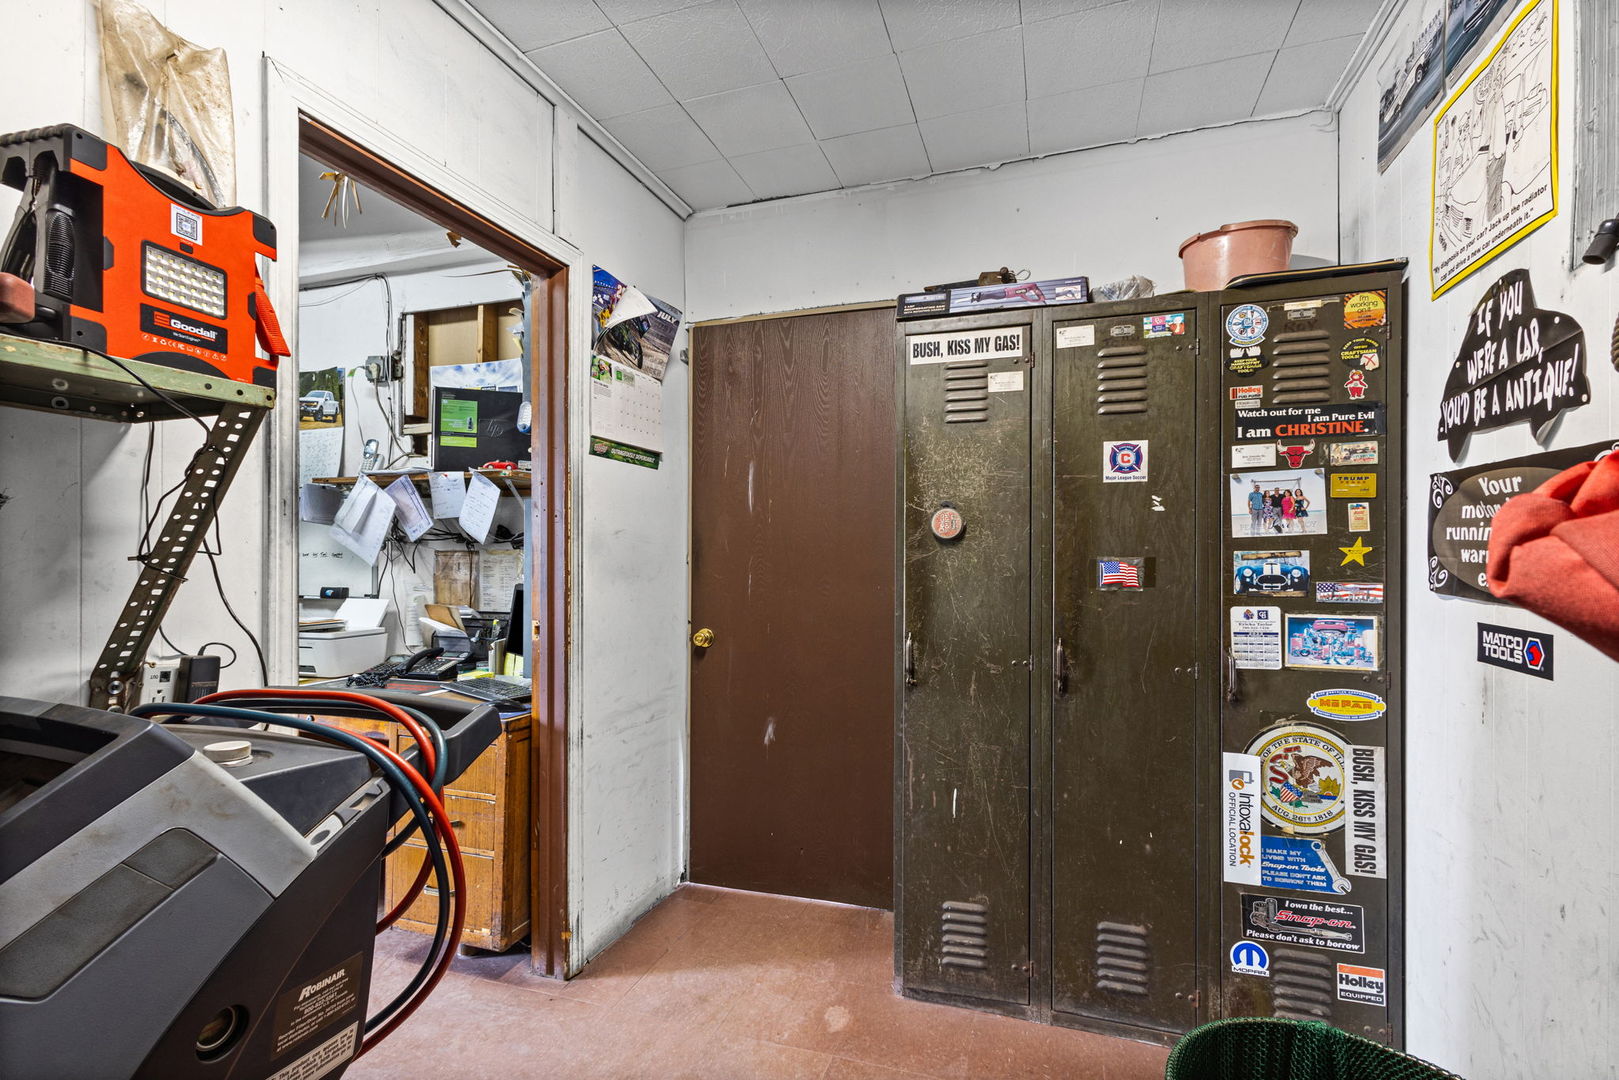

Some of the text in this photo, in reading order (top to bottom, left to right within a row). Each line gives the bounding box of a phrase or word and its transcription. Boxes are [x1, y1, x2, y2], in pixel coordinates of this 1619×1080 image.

[1466, 238, 1475, 251] your
[1477, 227, 1487, 240] car?
[1489, 218, 1501, 231] Jack
[1503, 212, 1509, 221] up
[1511, 204, 1520, 215] the
[1522, 184, 1547, 207] radiator
[1471, 248, 1480, 258] new
[1492, 216, 1522, 243] underneath
[1350, 300, 1378, 309] working
[1477, 281, 1523, 337] IF YOU
[656, 311, 676, 324] JULY
[170, 319, 216, 339] Goodall
[912, 334, 1020, 358] BUSH, KISS MY GAS!
[1467, 340, 1496, 385] WERE
[1498, 338, 1508, 369] A
[1442, 343, 1579, 433] YOU'D BE A ANTIQUE!
[1238, 421, 1370, 438] I am CHRISTINE.
[1478, 476, 1522, 496] Your
[1482, 630, 1523, 650] MATCO
[1482, 643, 1523, 664] TOOLS
[1263, 750, 1271, 760] OF
[1272, 738, 1290, 750] THE
[1292, 737, 1321, 748] STATE
[1322, 745, 1334, 754] OF
[1272, 805, 1291, 819] AUG.
[1314, 810, 1333, 822] 1818
[1352, 748, 1376, 875] BUSH, KISS MY GAS!
[1238, 791, 1255, 866] Intoxalock
[1261, 861, 1326, 872] Snap-on Tools
[1275, 910, 1352, 927] Snap-on
[1325, 905, 1353, 915] best...
[1247, 930, 1275, 939] Please
[1276, 933, 1298, 943] don't
[1327, 940, 1360, 950] borrow
[1233, 967, 1266, 975] MOPAR
[299, 969, 345, 1001] ROBINAIR
[1339, 974, 1384, 993] Holley
[1340, 992, 1382, 1002] EQUIPPED
